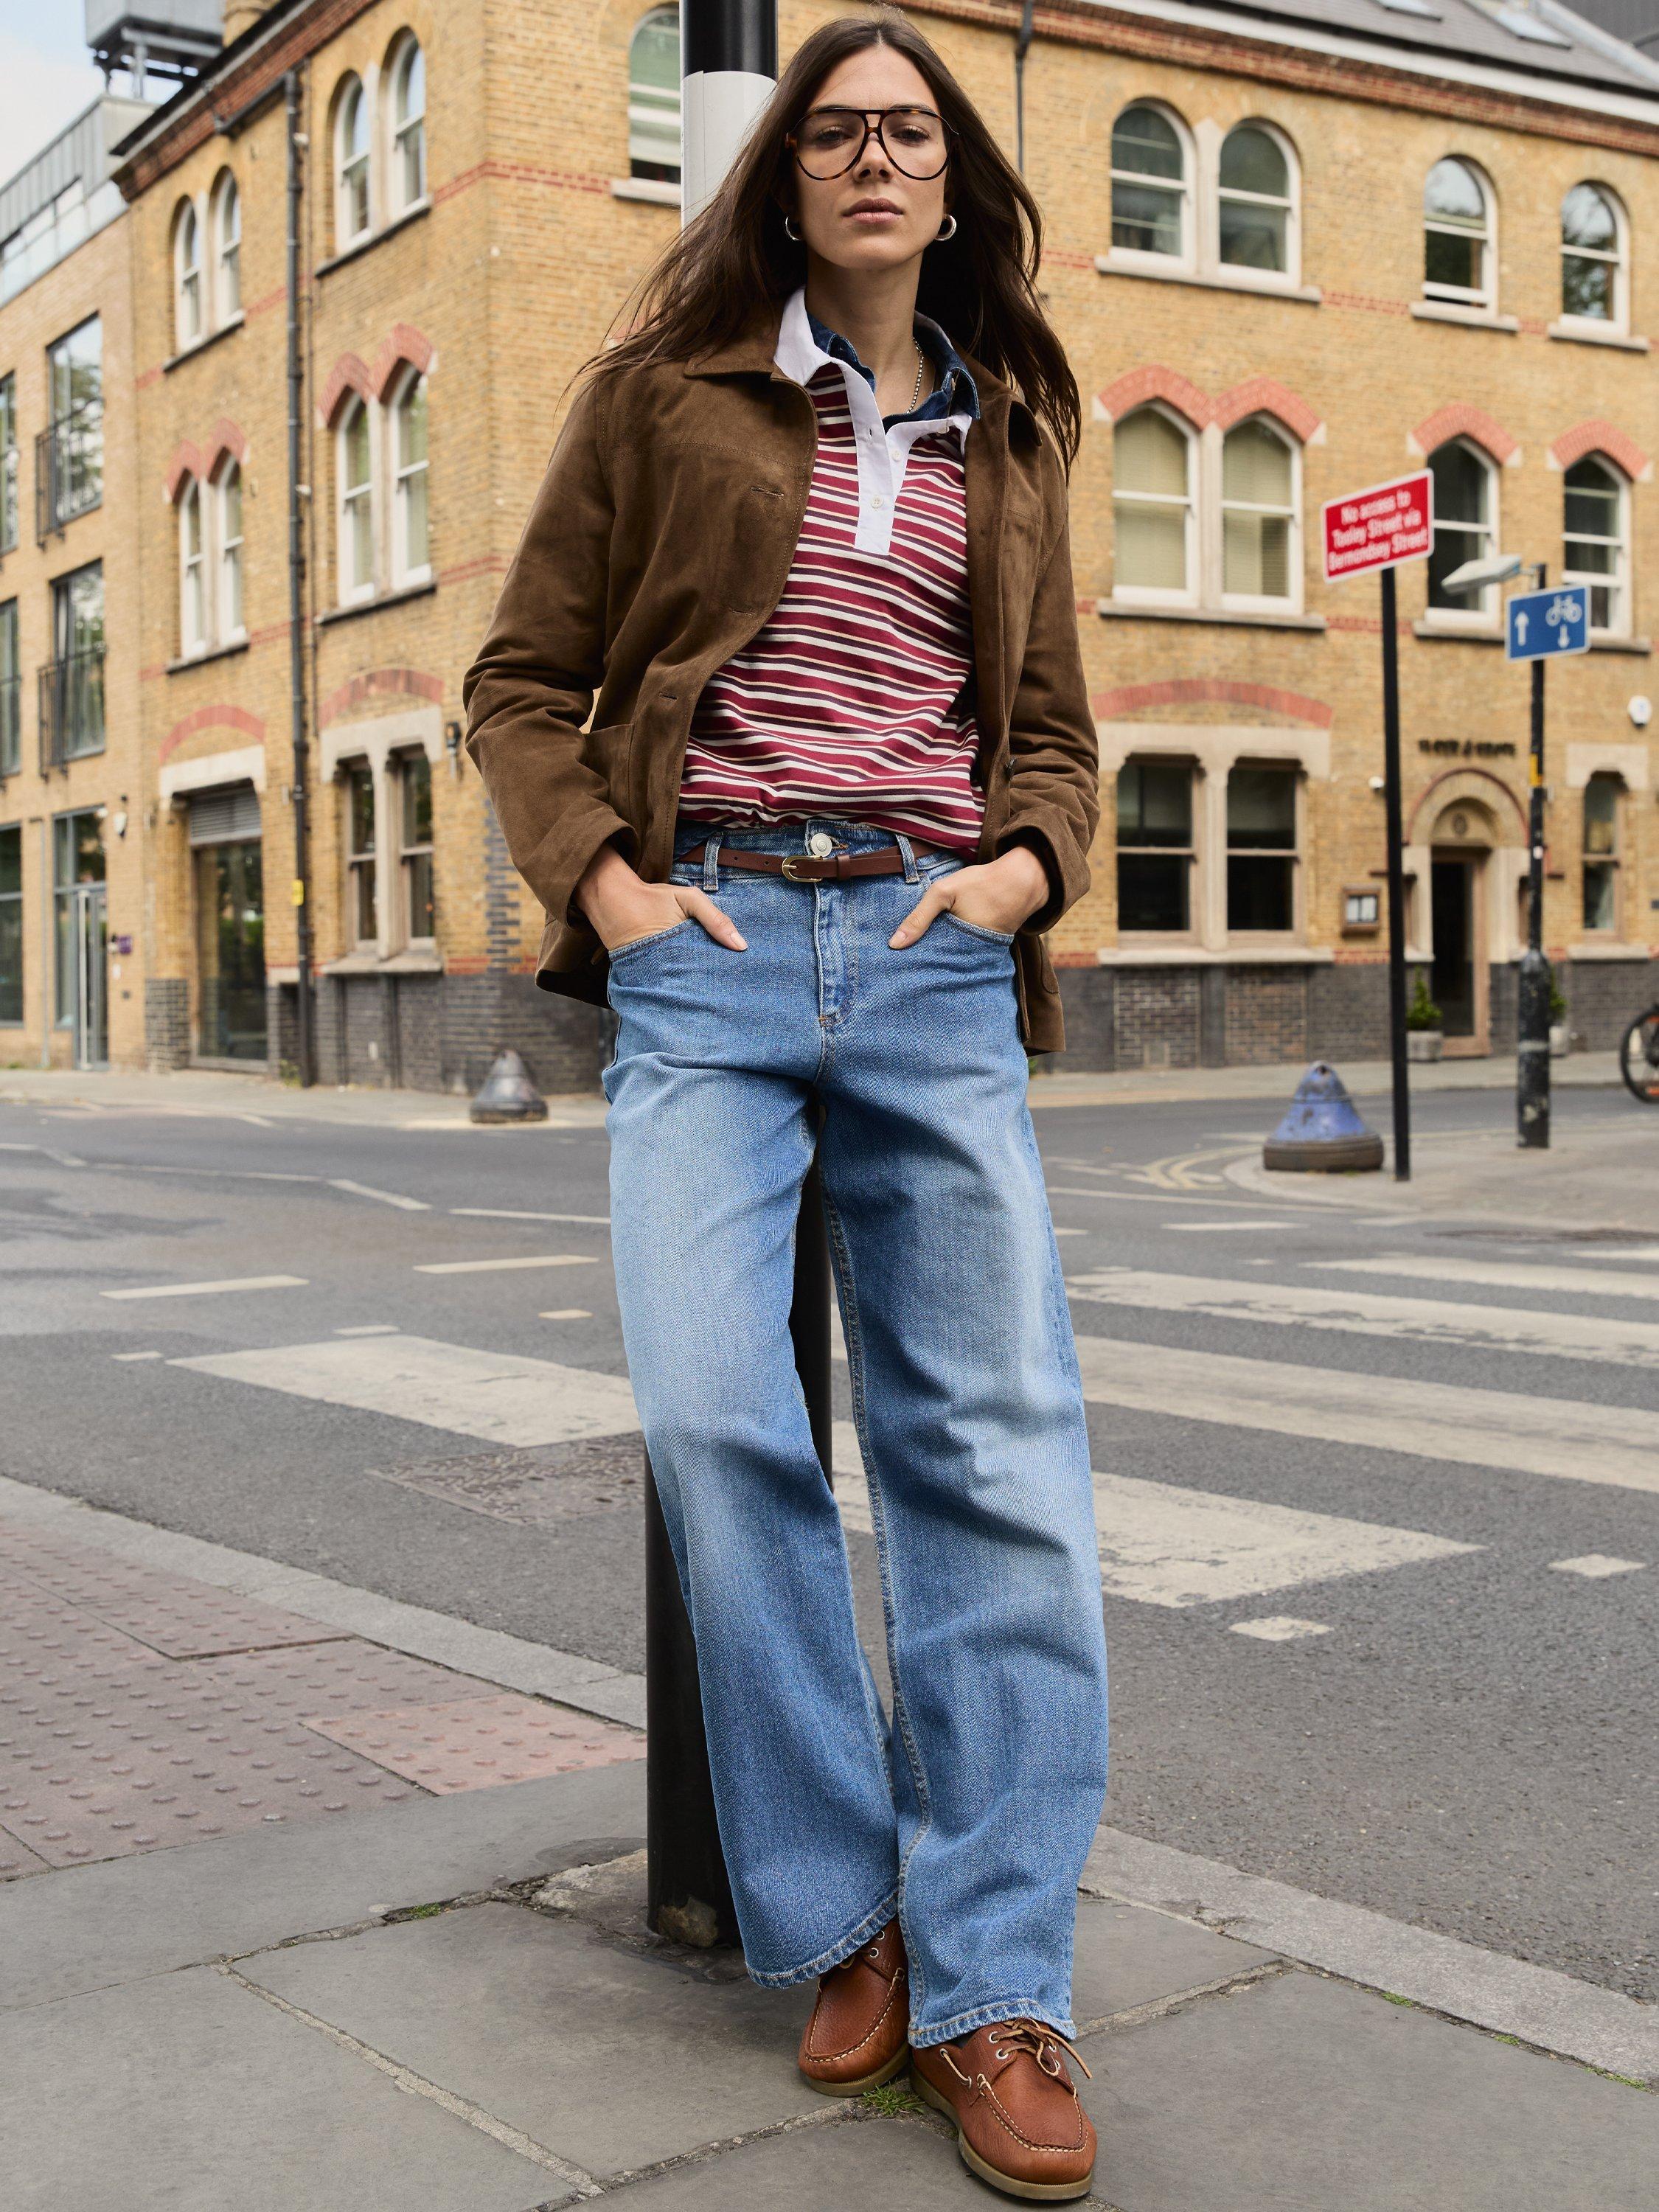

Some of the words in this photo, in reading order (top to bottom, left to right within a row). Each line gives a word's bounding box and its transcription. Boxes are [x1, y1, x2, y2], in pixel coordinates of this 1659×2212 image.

[1341, 506, 1358, 525] No
[1397, 490, 1411, 508] to
[1367, 512, 1402, 538] Street
[1403, 507, 1421, 527] via
[1391, 526, 1427, 553] Street
